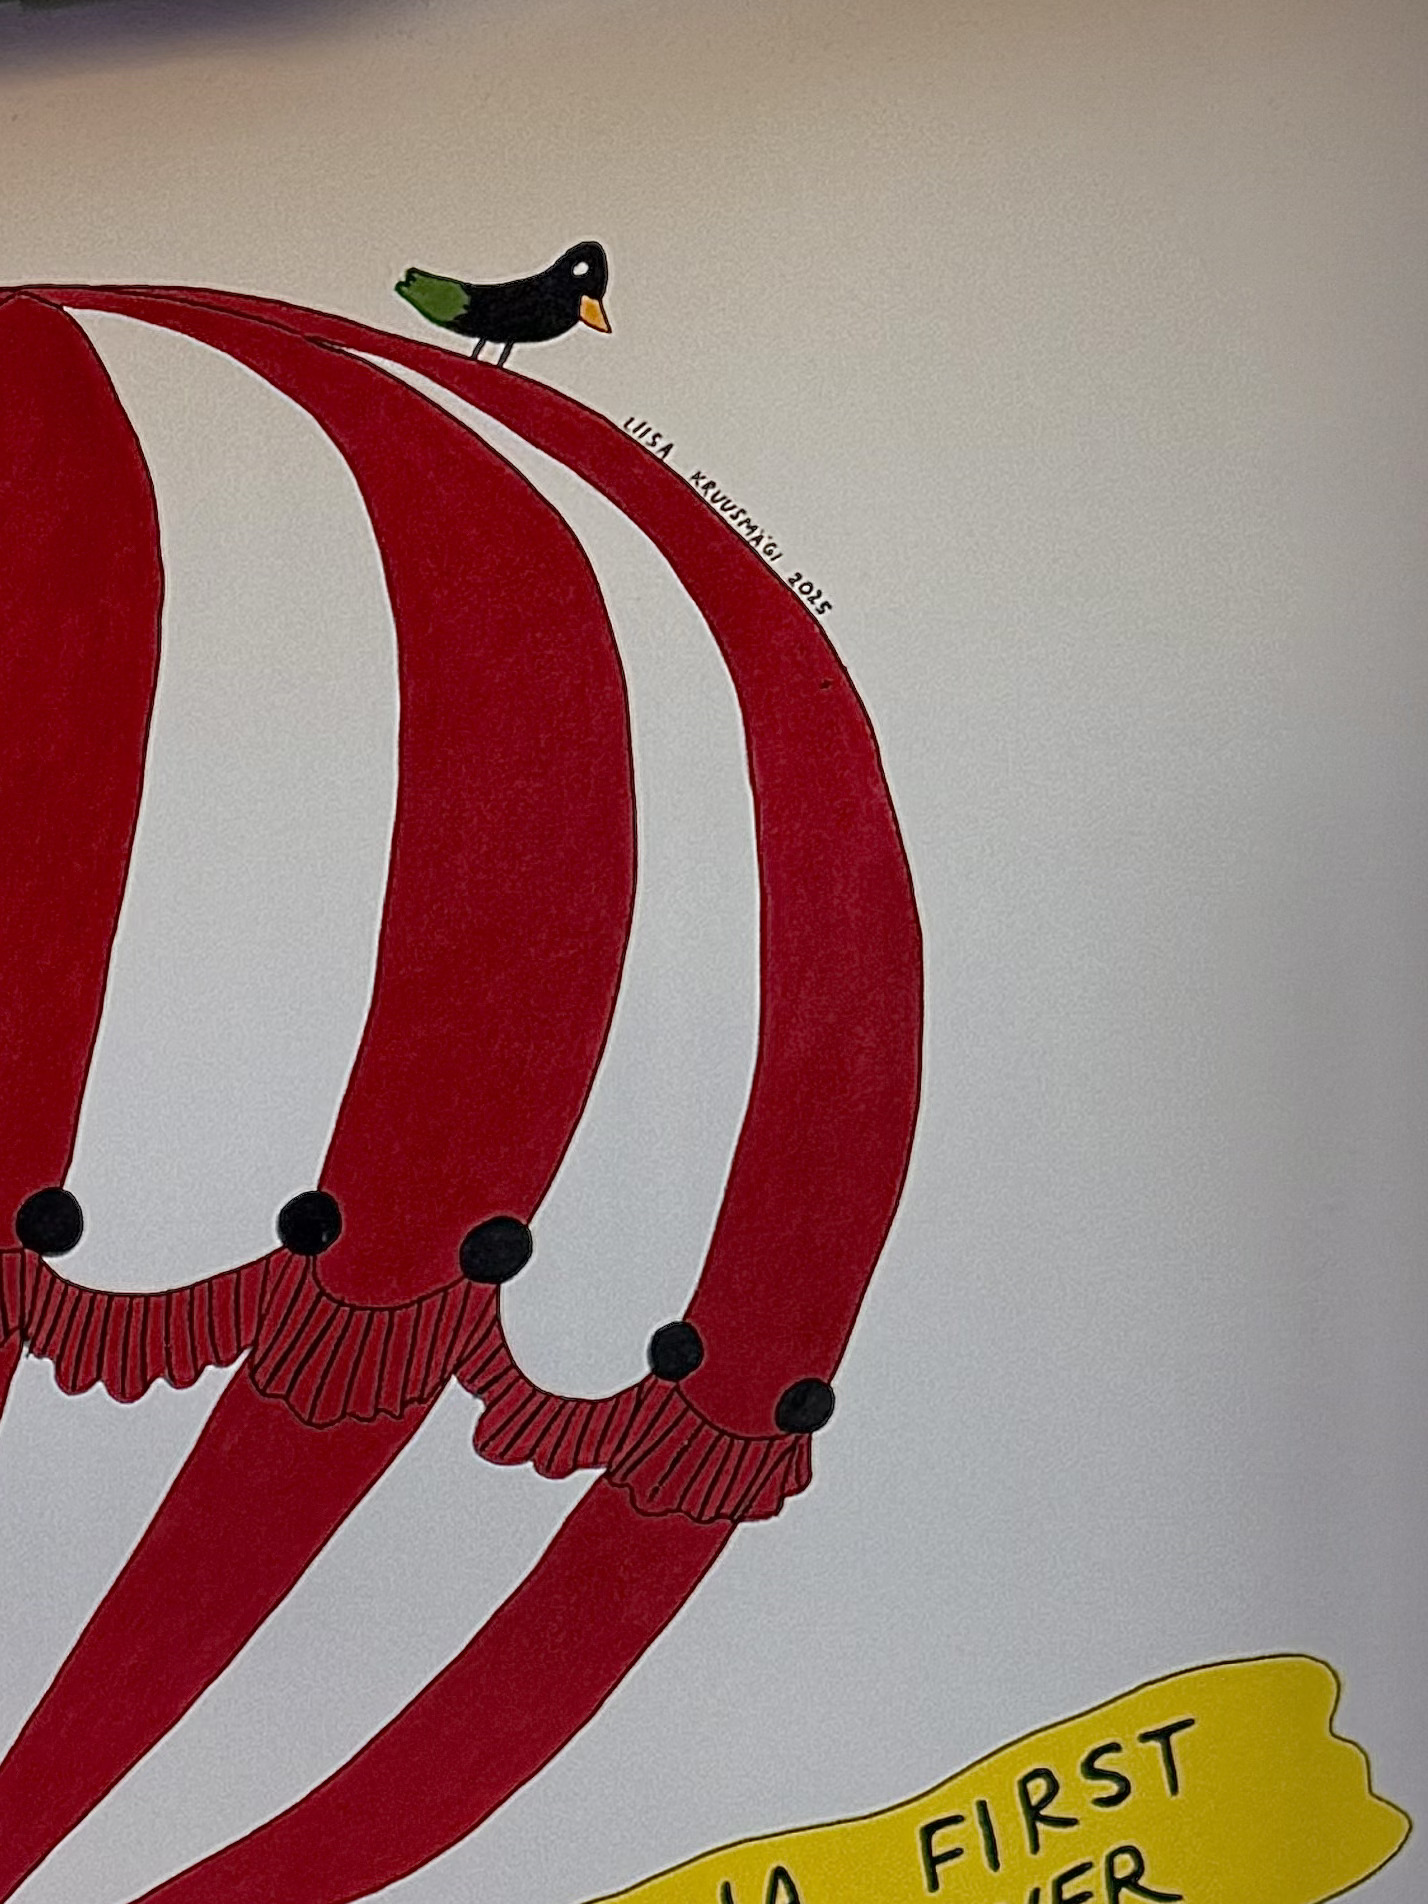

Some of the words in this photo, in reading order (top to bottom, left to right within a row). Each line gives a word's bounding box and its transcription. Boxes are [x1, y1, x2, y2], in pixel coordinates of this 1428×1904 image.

[622, 416, 675, 460] LIISA
[689, 470, 785, 563] KRUUSMÄGI
[787, 572, 834, 617] 2025
[918, 1717, 1197, 1894] FIRST
